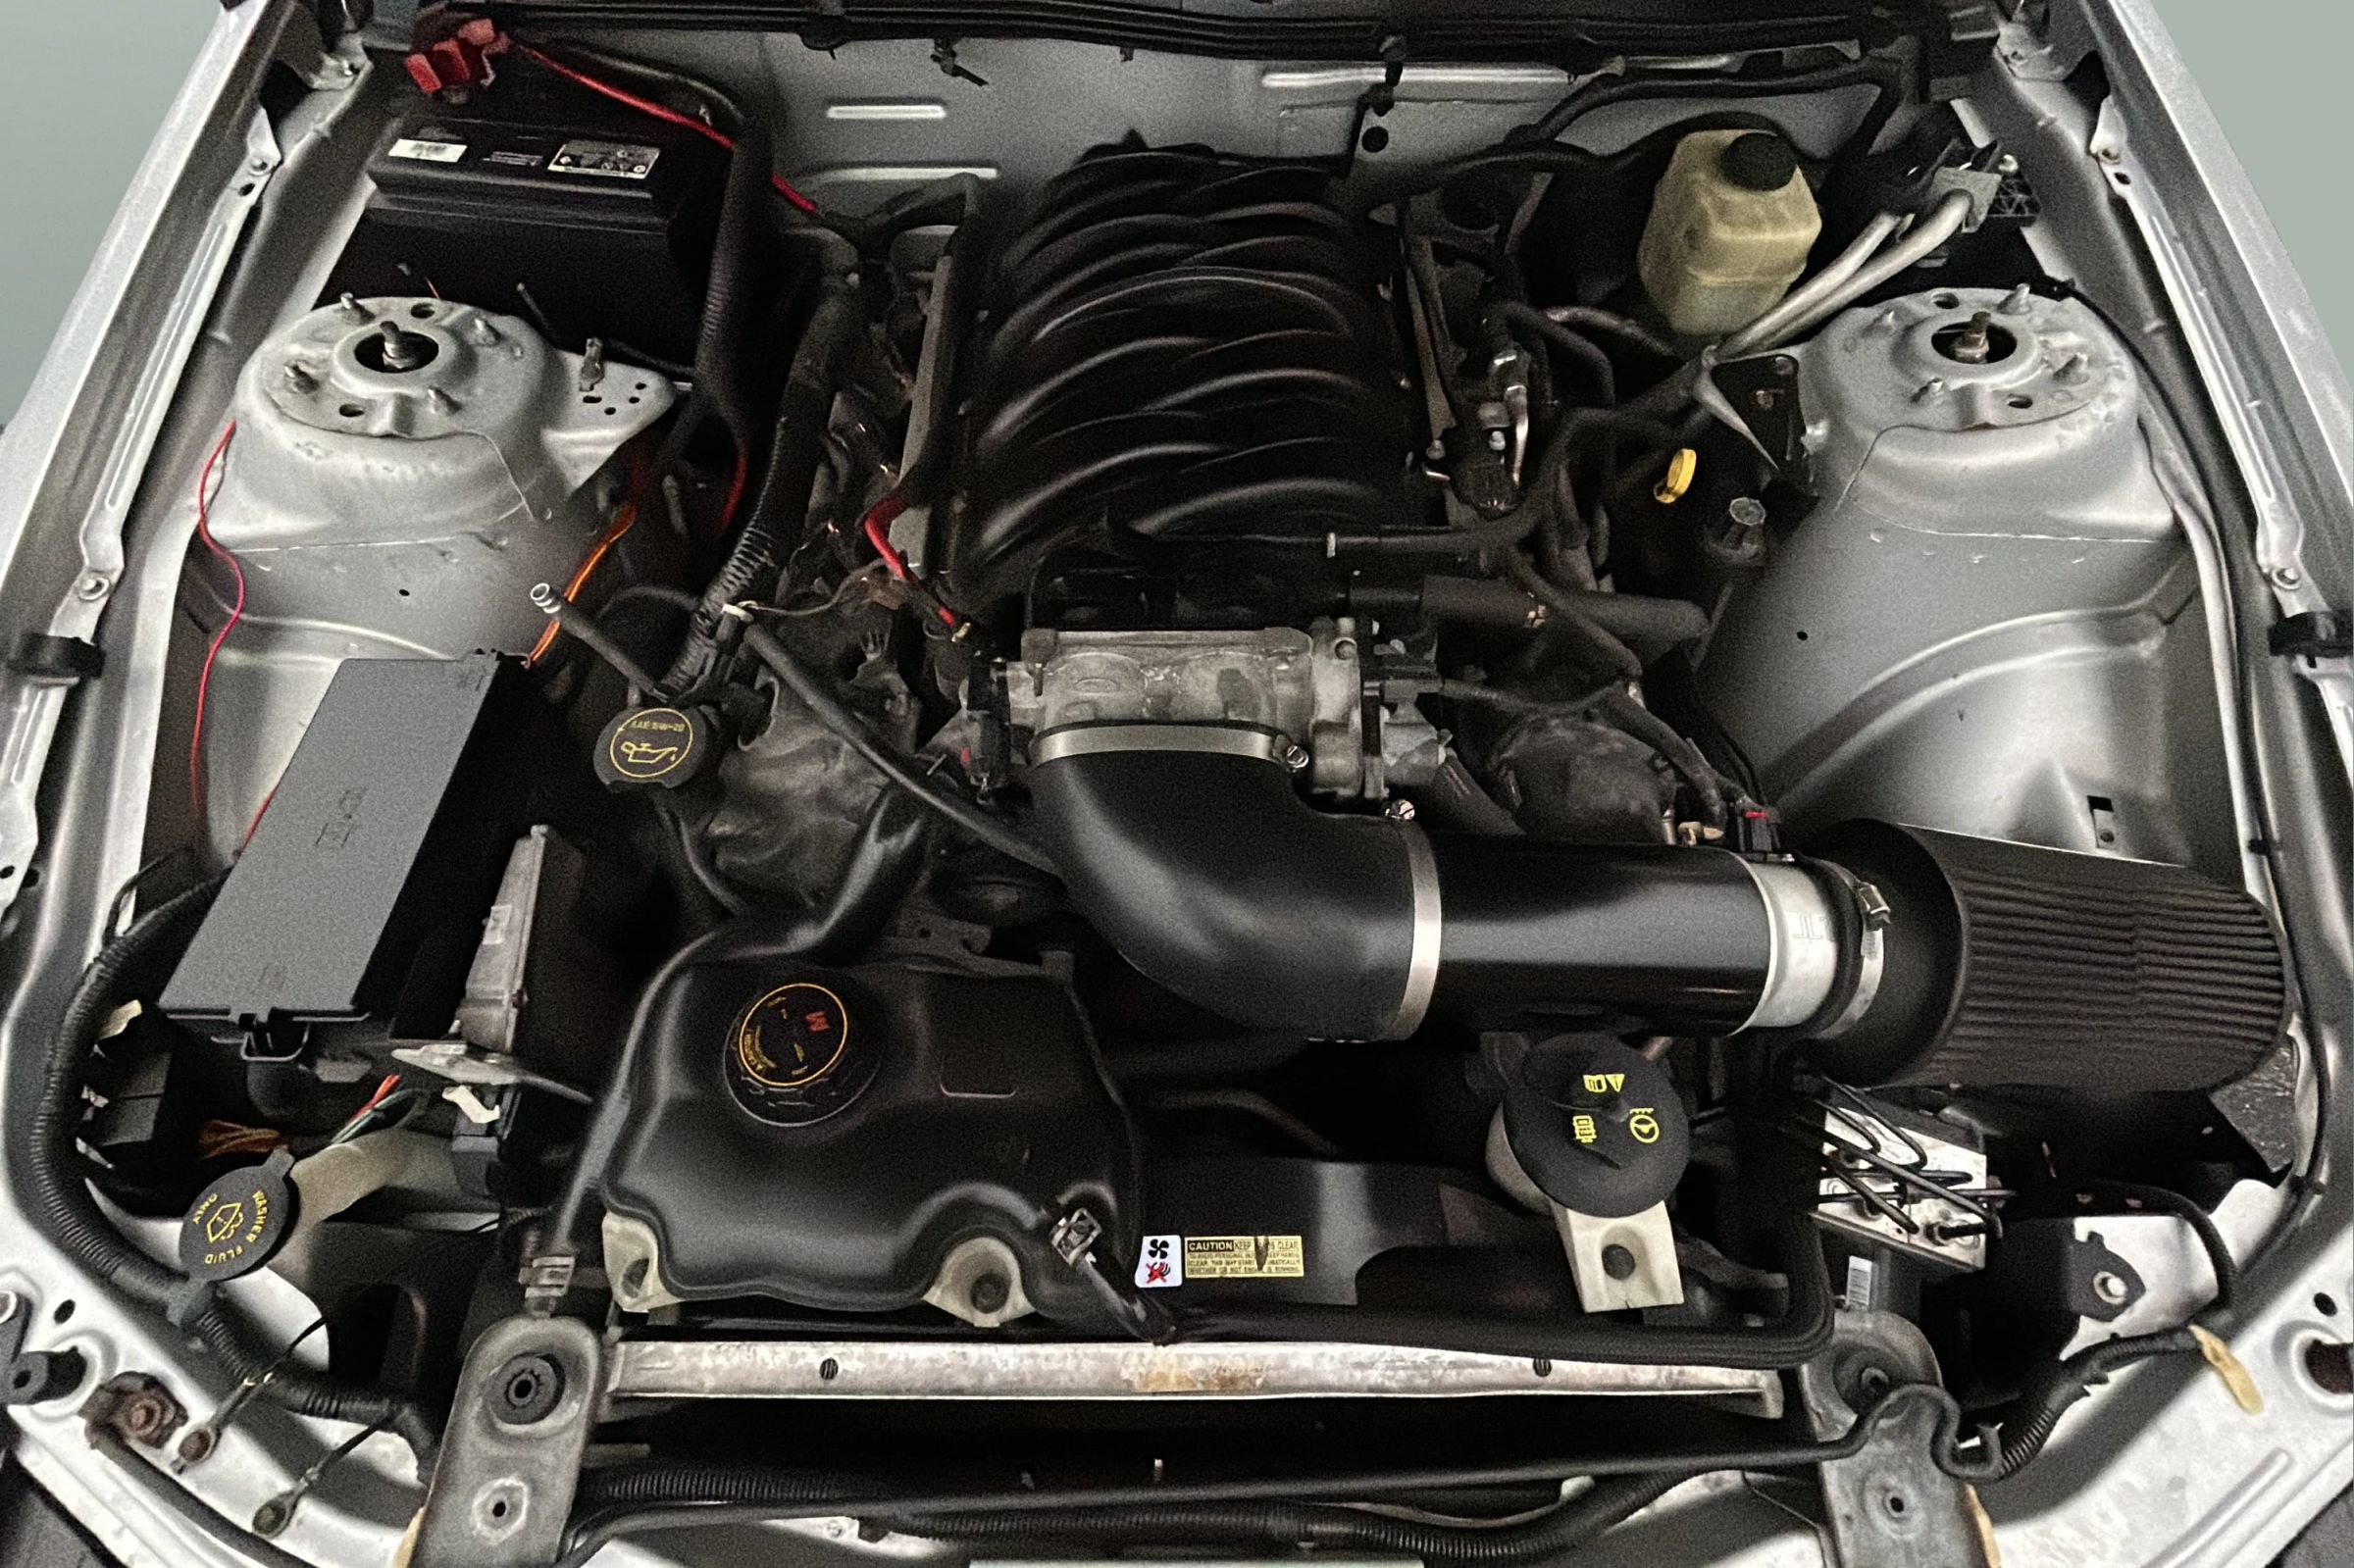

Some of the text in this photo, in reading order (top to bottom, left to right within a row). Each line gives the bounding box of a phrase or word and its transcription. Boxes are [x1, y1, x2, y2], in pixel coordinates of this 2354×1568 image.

[192, 1192, 218, 1225] ONLY
[204, 1189, 268, 1264] WASHER FLUID
[1188, 1240, 1233, 1251] CAUTION
[1234, 1239, 1252, 1250] KEEP
